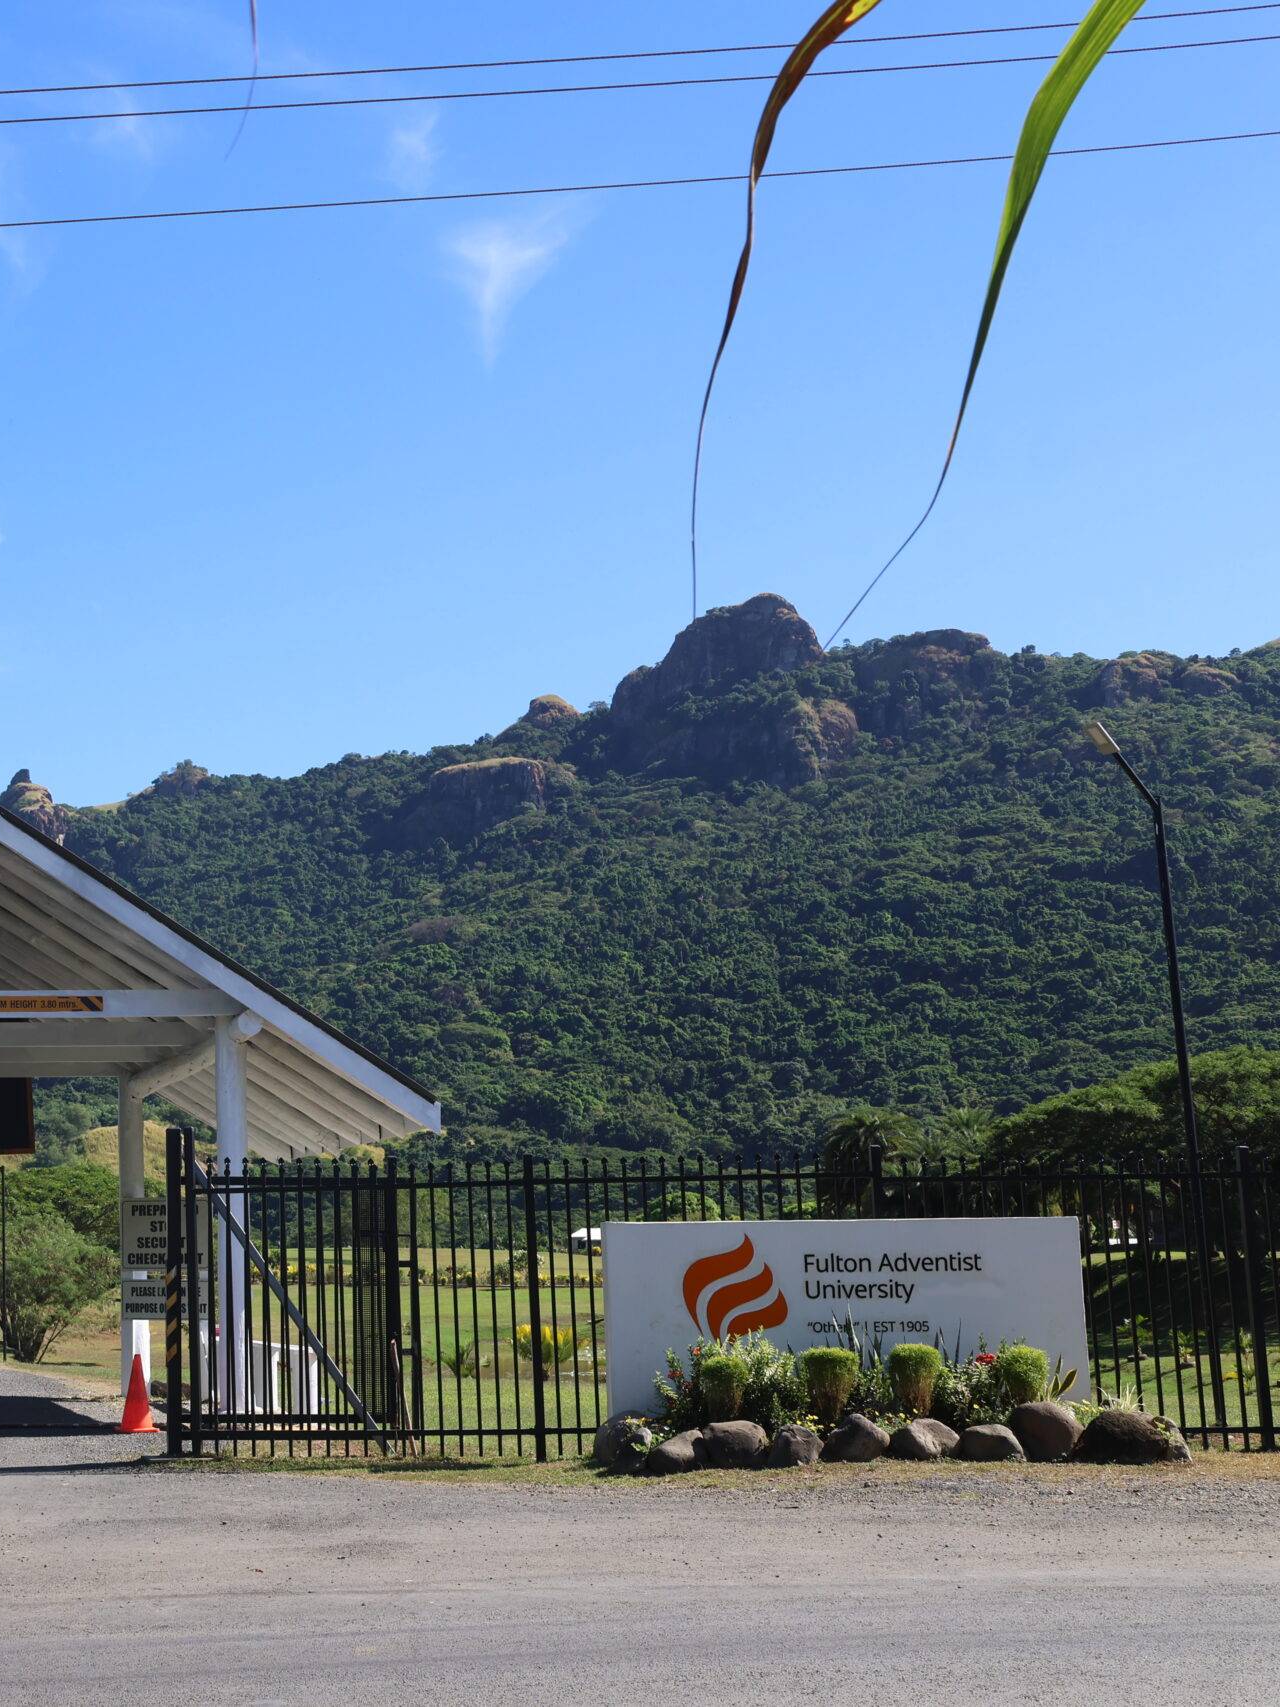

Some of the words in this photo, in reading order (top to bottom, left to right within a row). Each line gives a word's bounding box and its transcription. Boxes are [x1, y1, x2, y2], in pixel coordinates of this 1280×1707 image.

[10, 1000, 37, 1009] HEIGHT
[40, 1000, 57, 1009] 3.80
[131, 1204, 167, 1216] PREPA
[804, 1253, 872, 1273] Fulton
[878, 1252, 982, 1272] Adventist
[131, 1286, 156, 1297] PLEASE
[805, 1279, 915, 1304] University
[125, 1303, 158, 1313] PURPOSE
[873, 1321, 896, 1333] EST
[899, 1320, 930, 1333] 1905
